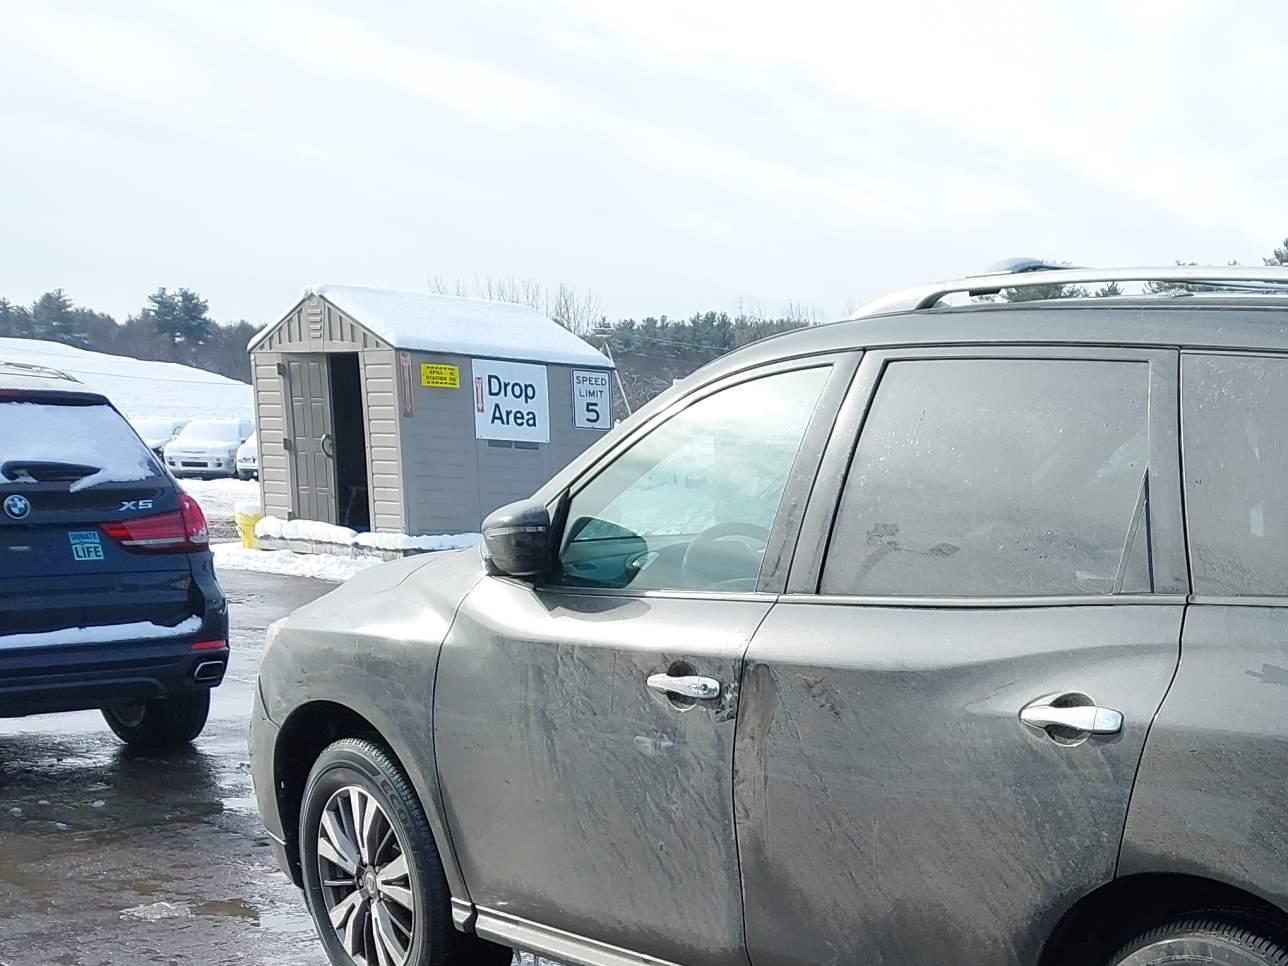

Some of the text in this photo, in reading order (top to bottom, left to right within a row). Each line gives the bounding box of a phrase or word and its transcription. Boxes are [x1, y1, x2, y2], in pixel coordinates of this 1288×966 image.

[575, 376, 607, 386] SPEED
[487, 374, 536, 404] Drop
[579, 389, 604, 399] LIMIT
[490, 403, 537, 427] Area
[585, 402, 600, 423] 5
[119, 499, 153, 511] X5
[74, 546, 102, 558] LIFE
